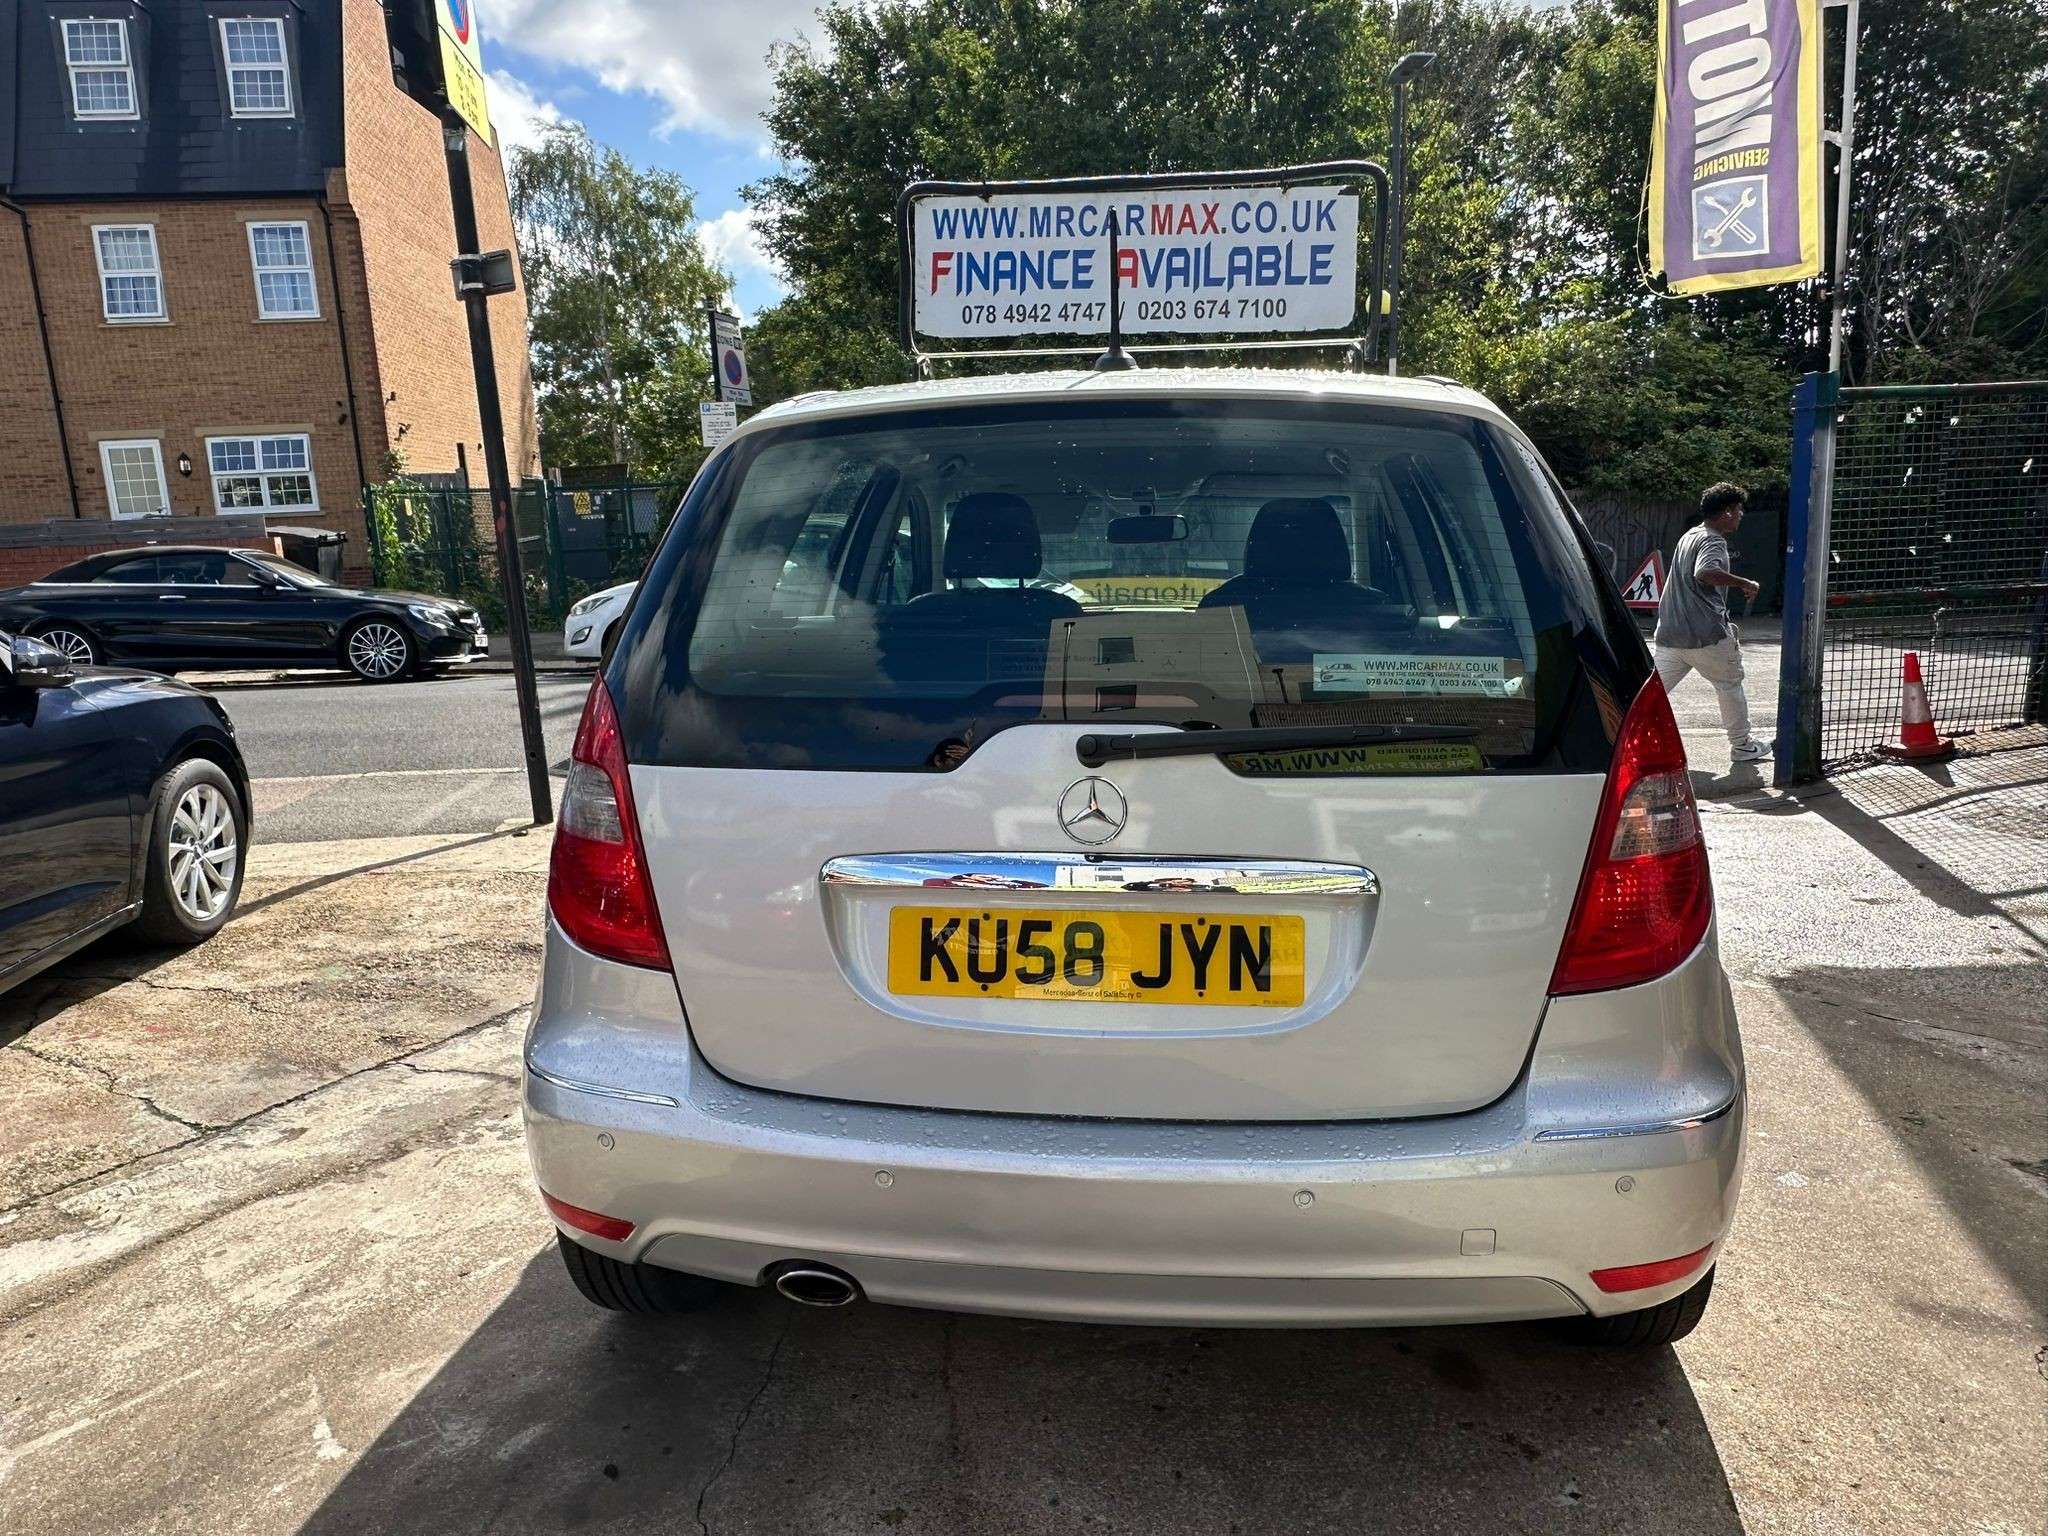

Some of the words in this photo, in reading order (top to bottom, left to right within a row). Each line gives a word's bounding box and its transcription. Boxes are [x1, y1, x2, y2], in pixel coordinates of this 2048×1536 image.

[932, 199, 1337, 239] WWW.MRCARMAX.CO.UK
[931, 249, 1097, 296] FINANCE
[1117, 239, 1335, 293] AVAILABLE
[962, 304, 996, 324] 078
[1003, 303, 1051, 323] 4942
[1058, 302, 1106, 322] 4747
[1137, 300, 1187, 320] 0203
[1193, 299, 1231, 319] 674
[1237, 298, 1287, 318] 7100
[1364, 660, 1499, 672] WWW.MRCARMAX.CO.UK
[919, 917, 1104, 986] KU58
[1130, 922, 1272, 993] JYN
[1103, 990, 1134, 999] Salisbury
